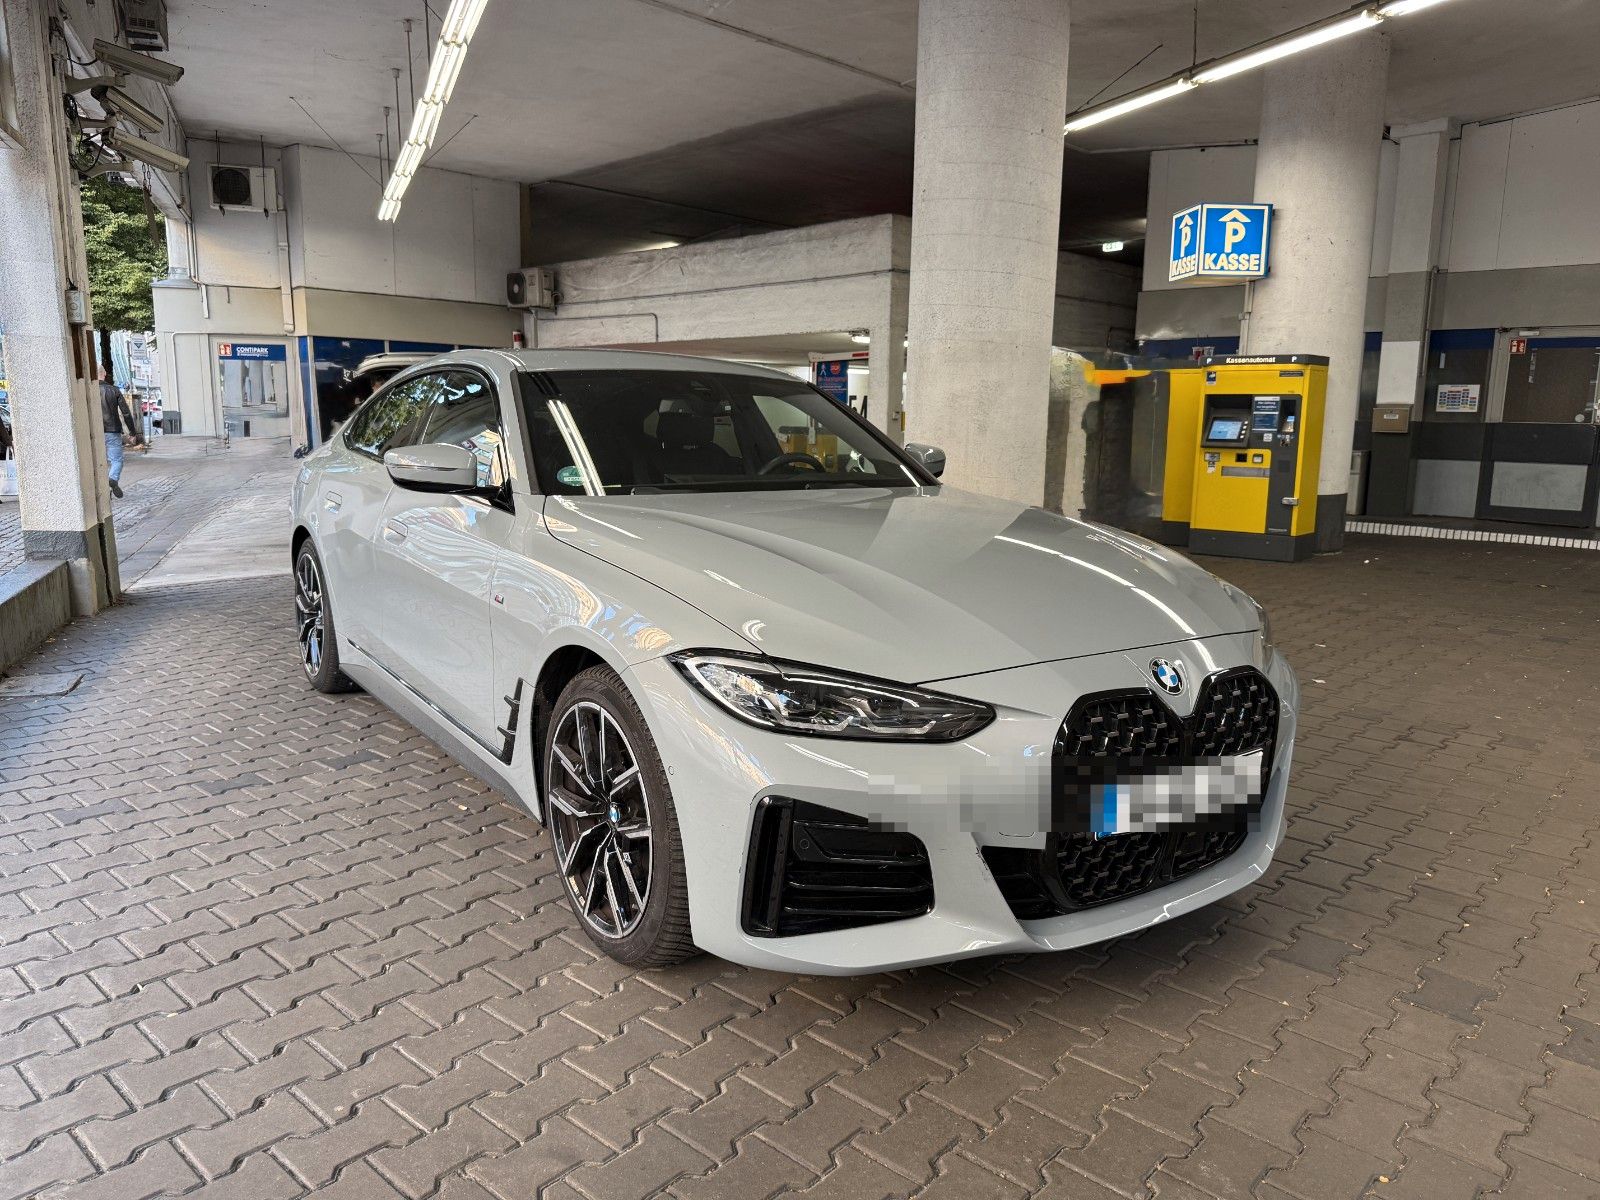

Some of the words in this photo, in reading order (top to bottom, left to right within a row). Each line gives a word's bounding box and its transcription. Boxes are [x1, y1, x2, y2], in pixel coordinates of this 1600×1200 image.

[1180, 226, 1191, 258] P
[1224, 221, 1246, 253] P
[1170, 253, 1197, 277] KASSE
[1203, 252, 1260, 271] KASSE
